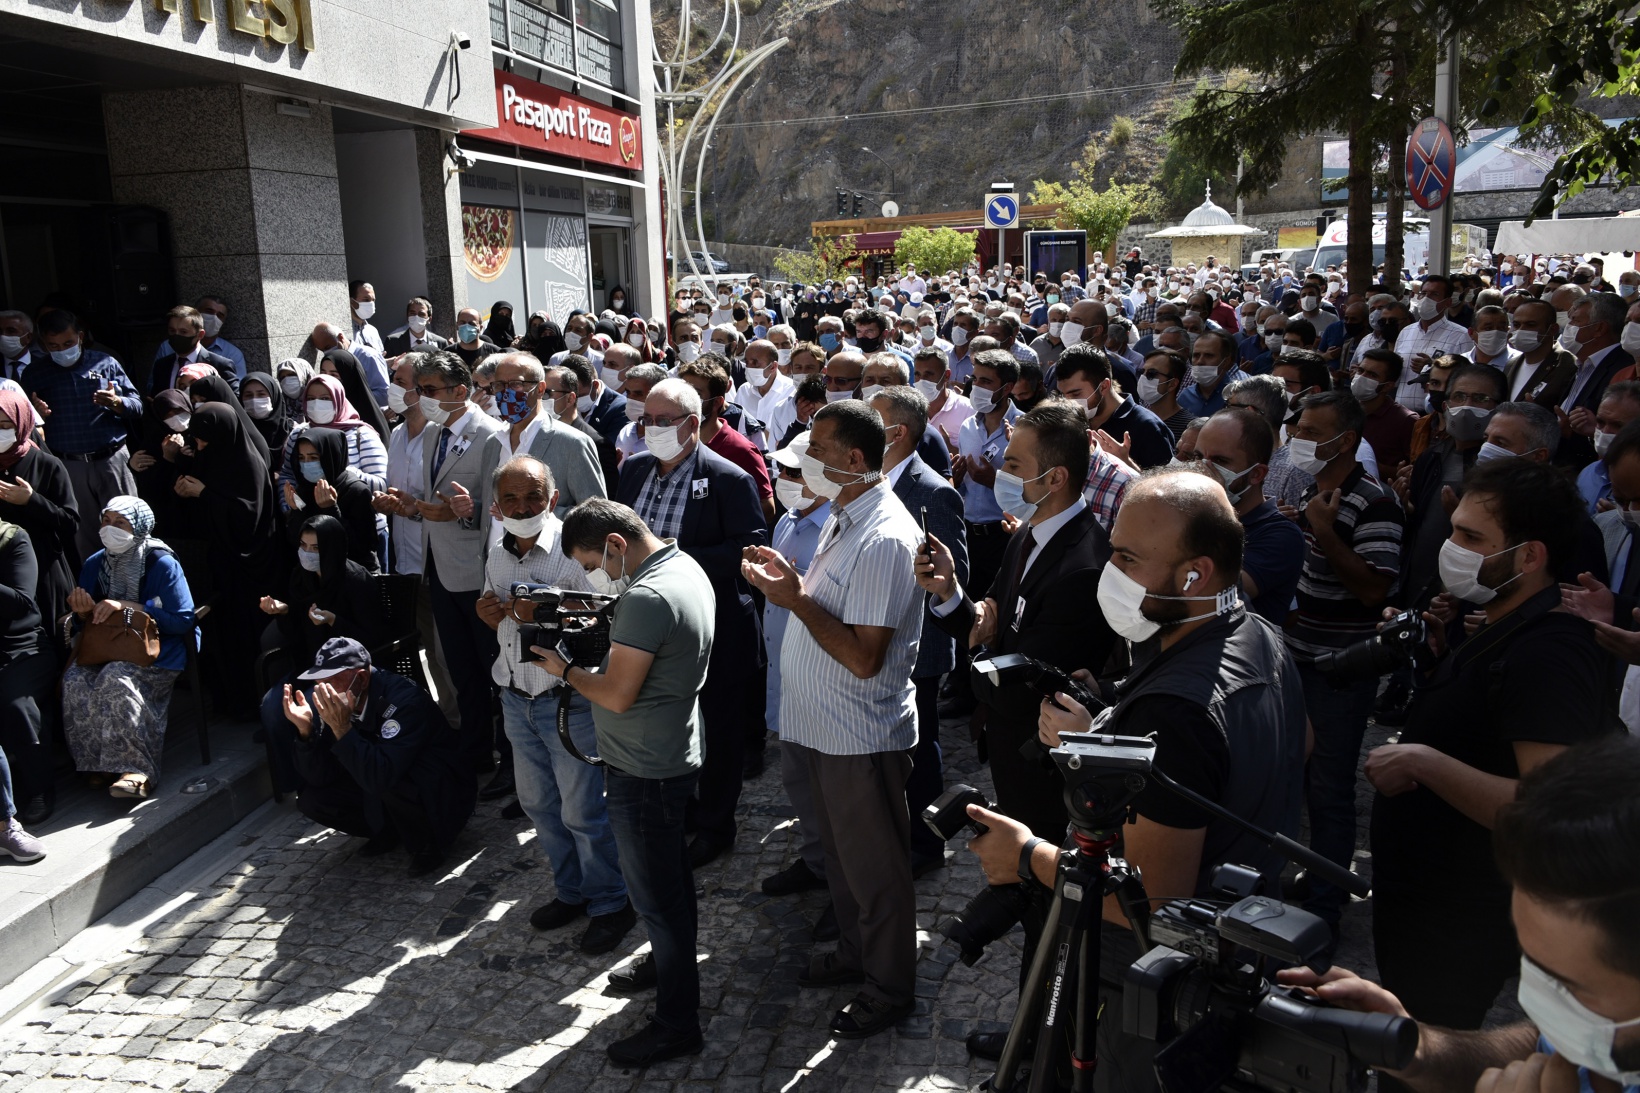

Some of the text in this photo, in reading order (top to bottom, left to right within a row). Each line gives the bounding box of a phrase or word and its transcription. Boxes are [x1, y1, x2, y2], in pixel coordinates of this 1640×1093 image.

[502, 83, 612, 146] Pasaport Pizza
[1046, 975, 1062, 1027] Manfrotto
